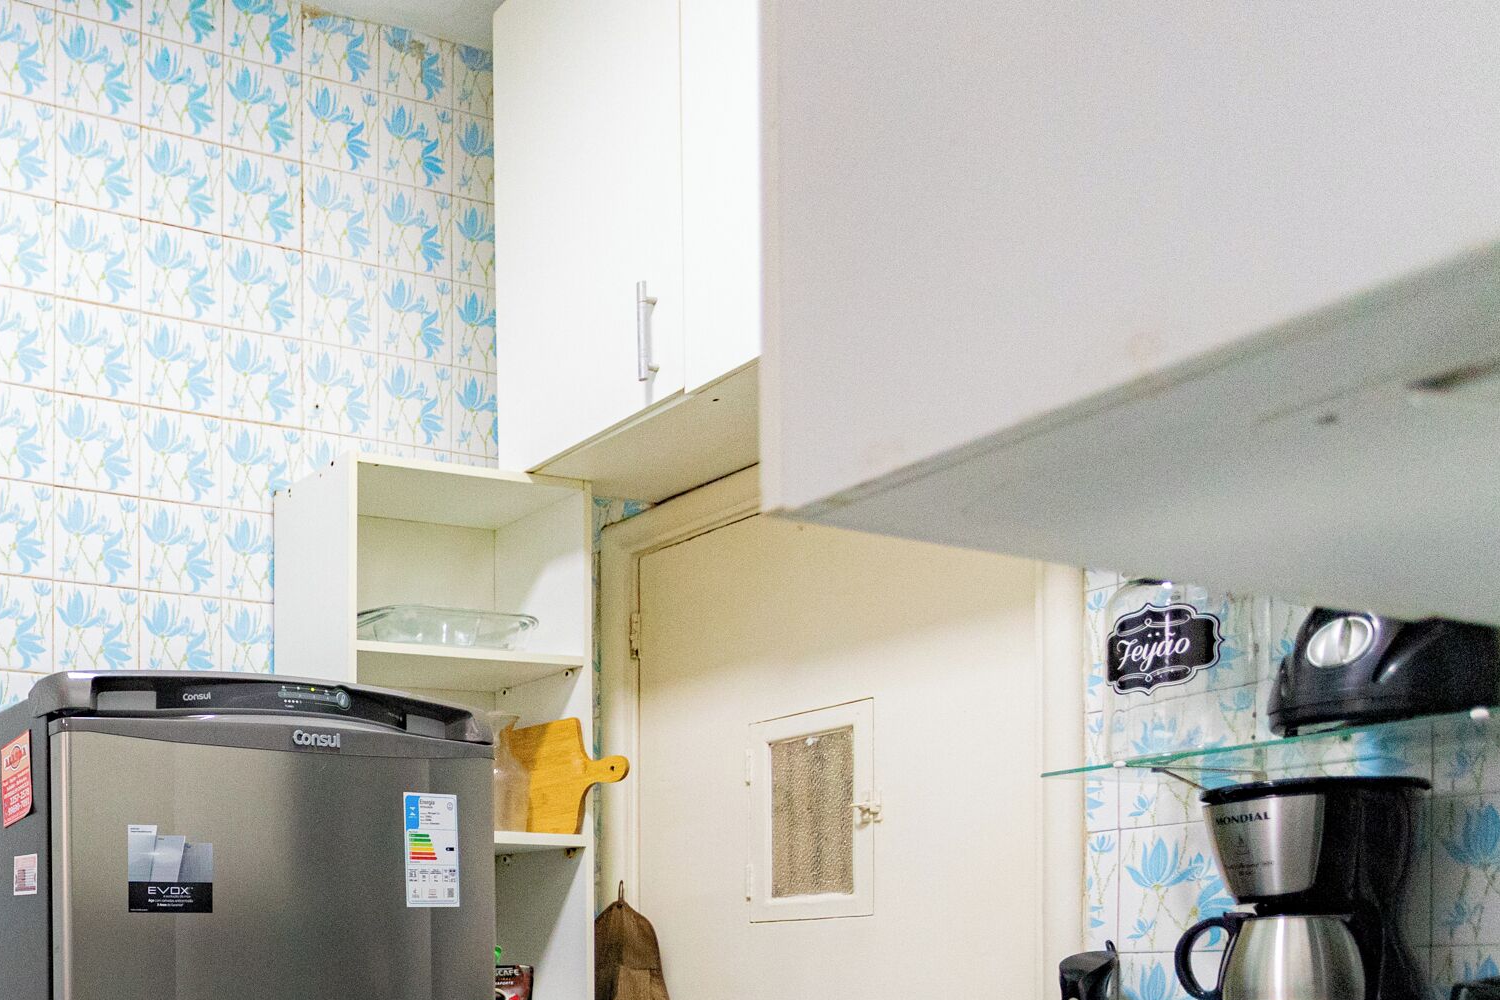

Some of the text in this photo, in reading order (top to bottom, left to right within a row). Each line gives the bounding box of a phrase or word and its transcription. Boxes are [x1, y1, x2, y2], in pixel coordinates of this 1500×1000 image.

[1116, 632, 1191, 672] Feijão
[182, 691, 212, 701] Consul
[292, 729, 341, 748] Consul
[1216, 811, 1270, 826] MONDIAL
